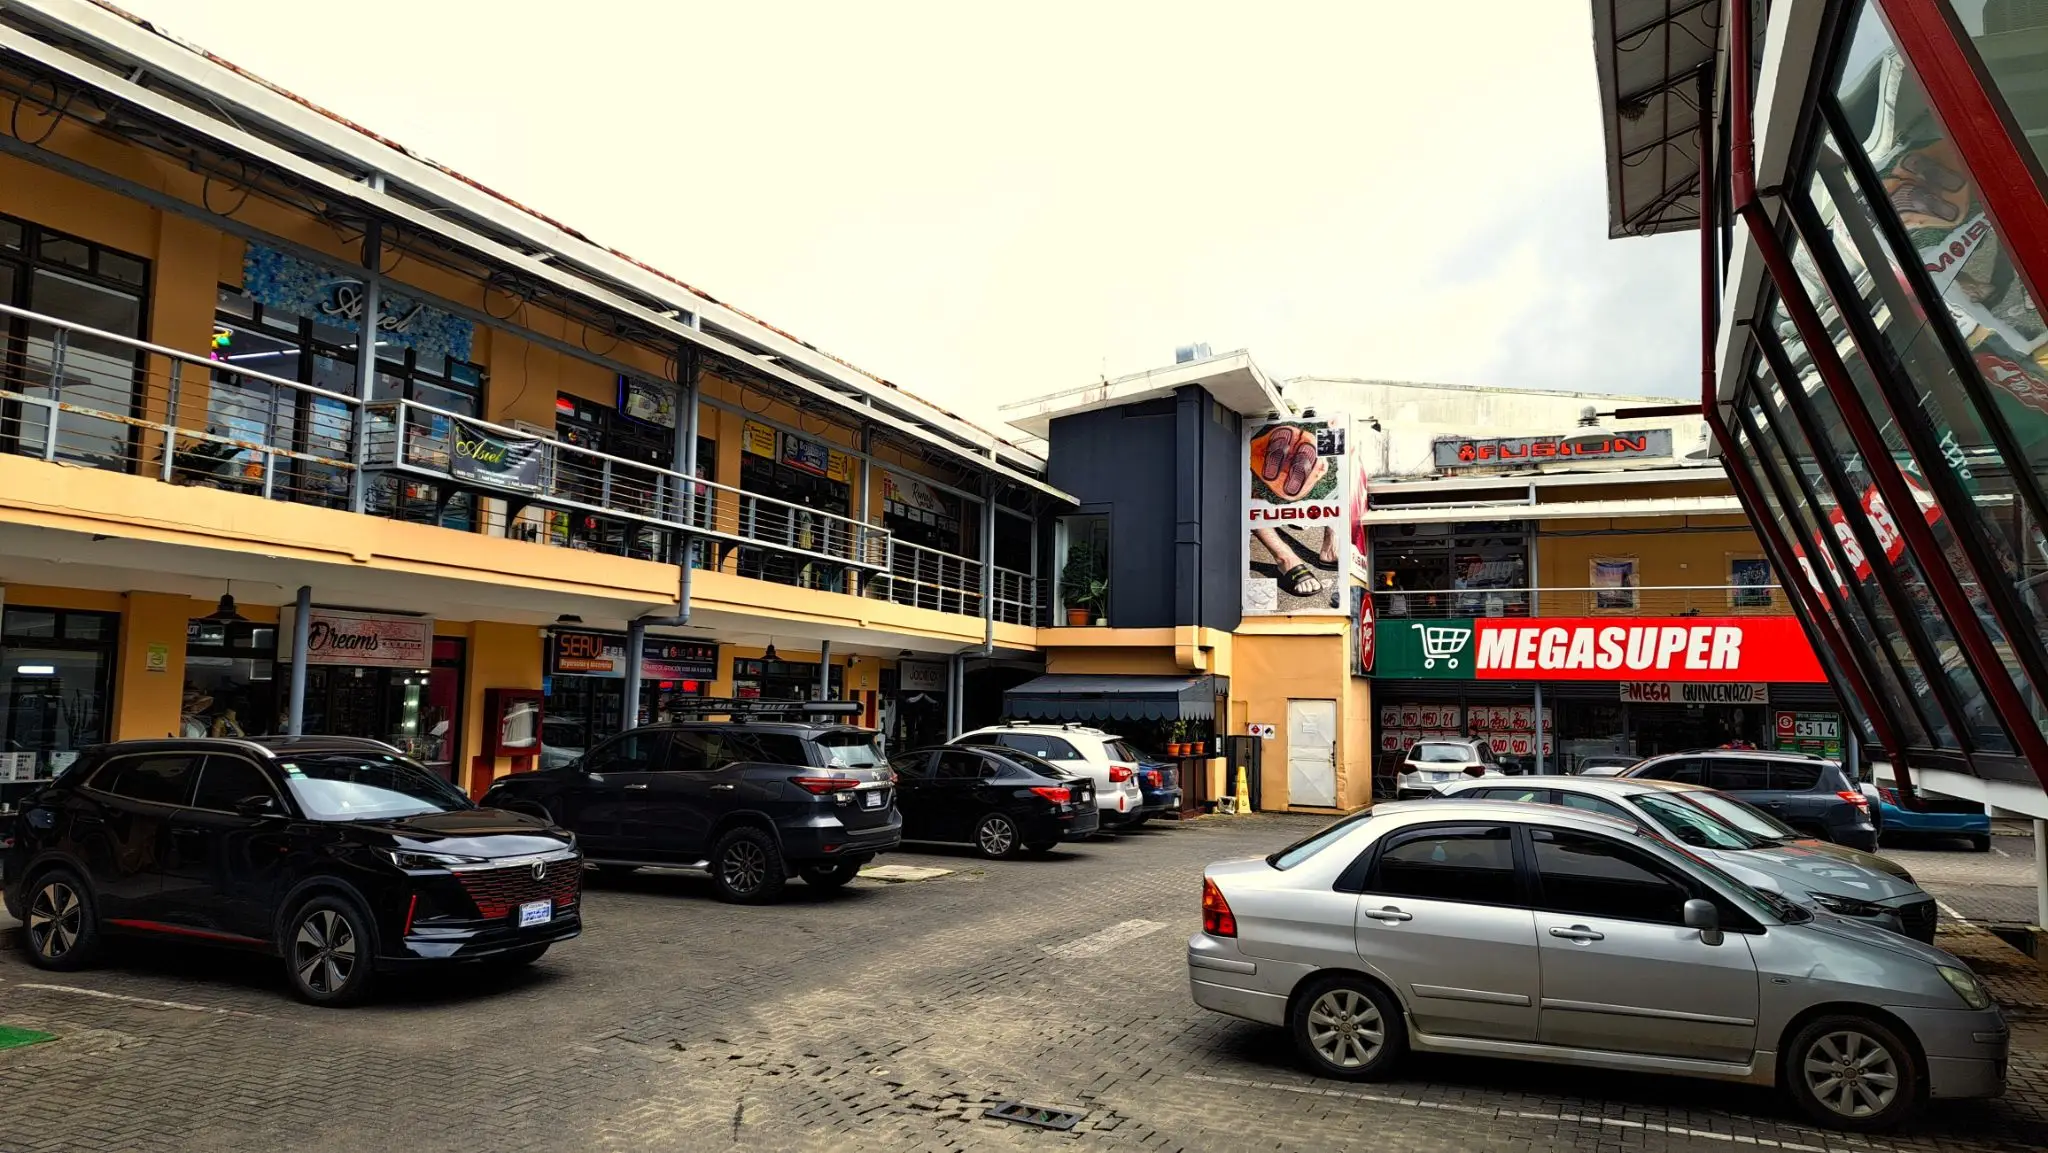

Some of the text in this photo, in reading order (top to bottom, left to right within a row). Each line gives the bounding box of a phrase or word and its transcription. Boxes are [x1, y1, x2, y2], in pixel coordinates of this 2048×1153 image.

[456, 439, 507, 464] Asiel
[1478, 436, 1647, 460] FUSION
[1249, 505, 1340, 521] FUSION
[308, 621, 378, 651] Dreams
[1476, 626, 1743, 670] MEGASUPER
[1628, 682, 1754, 701] MEGA QUINCENAZO
